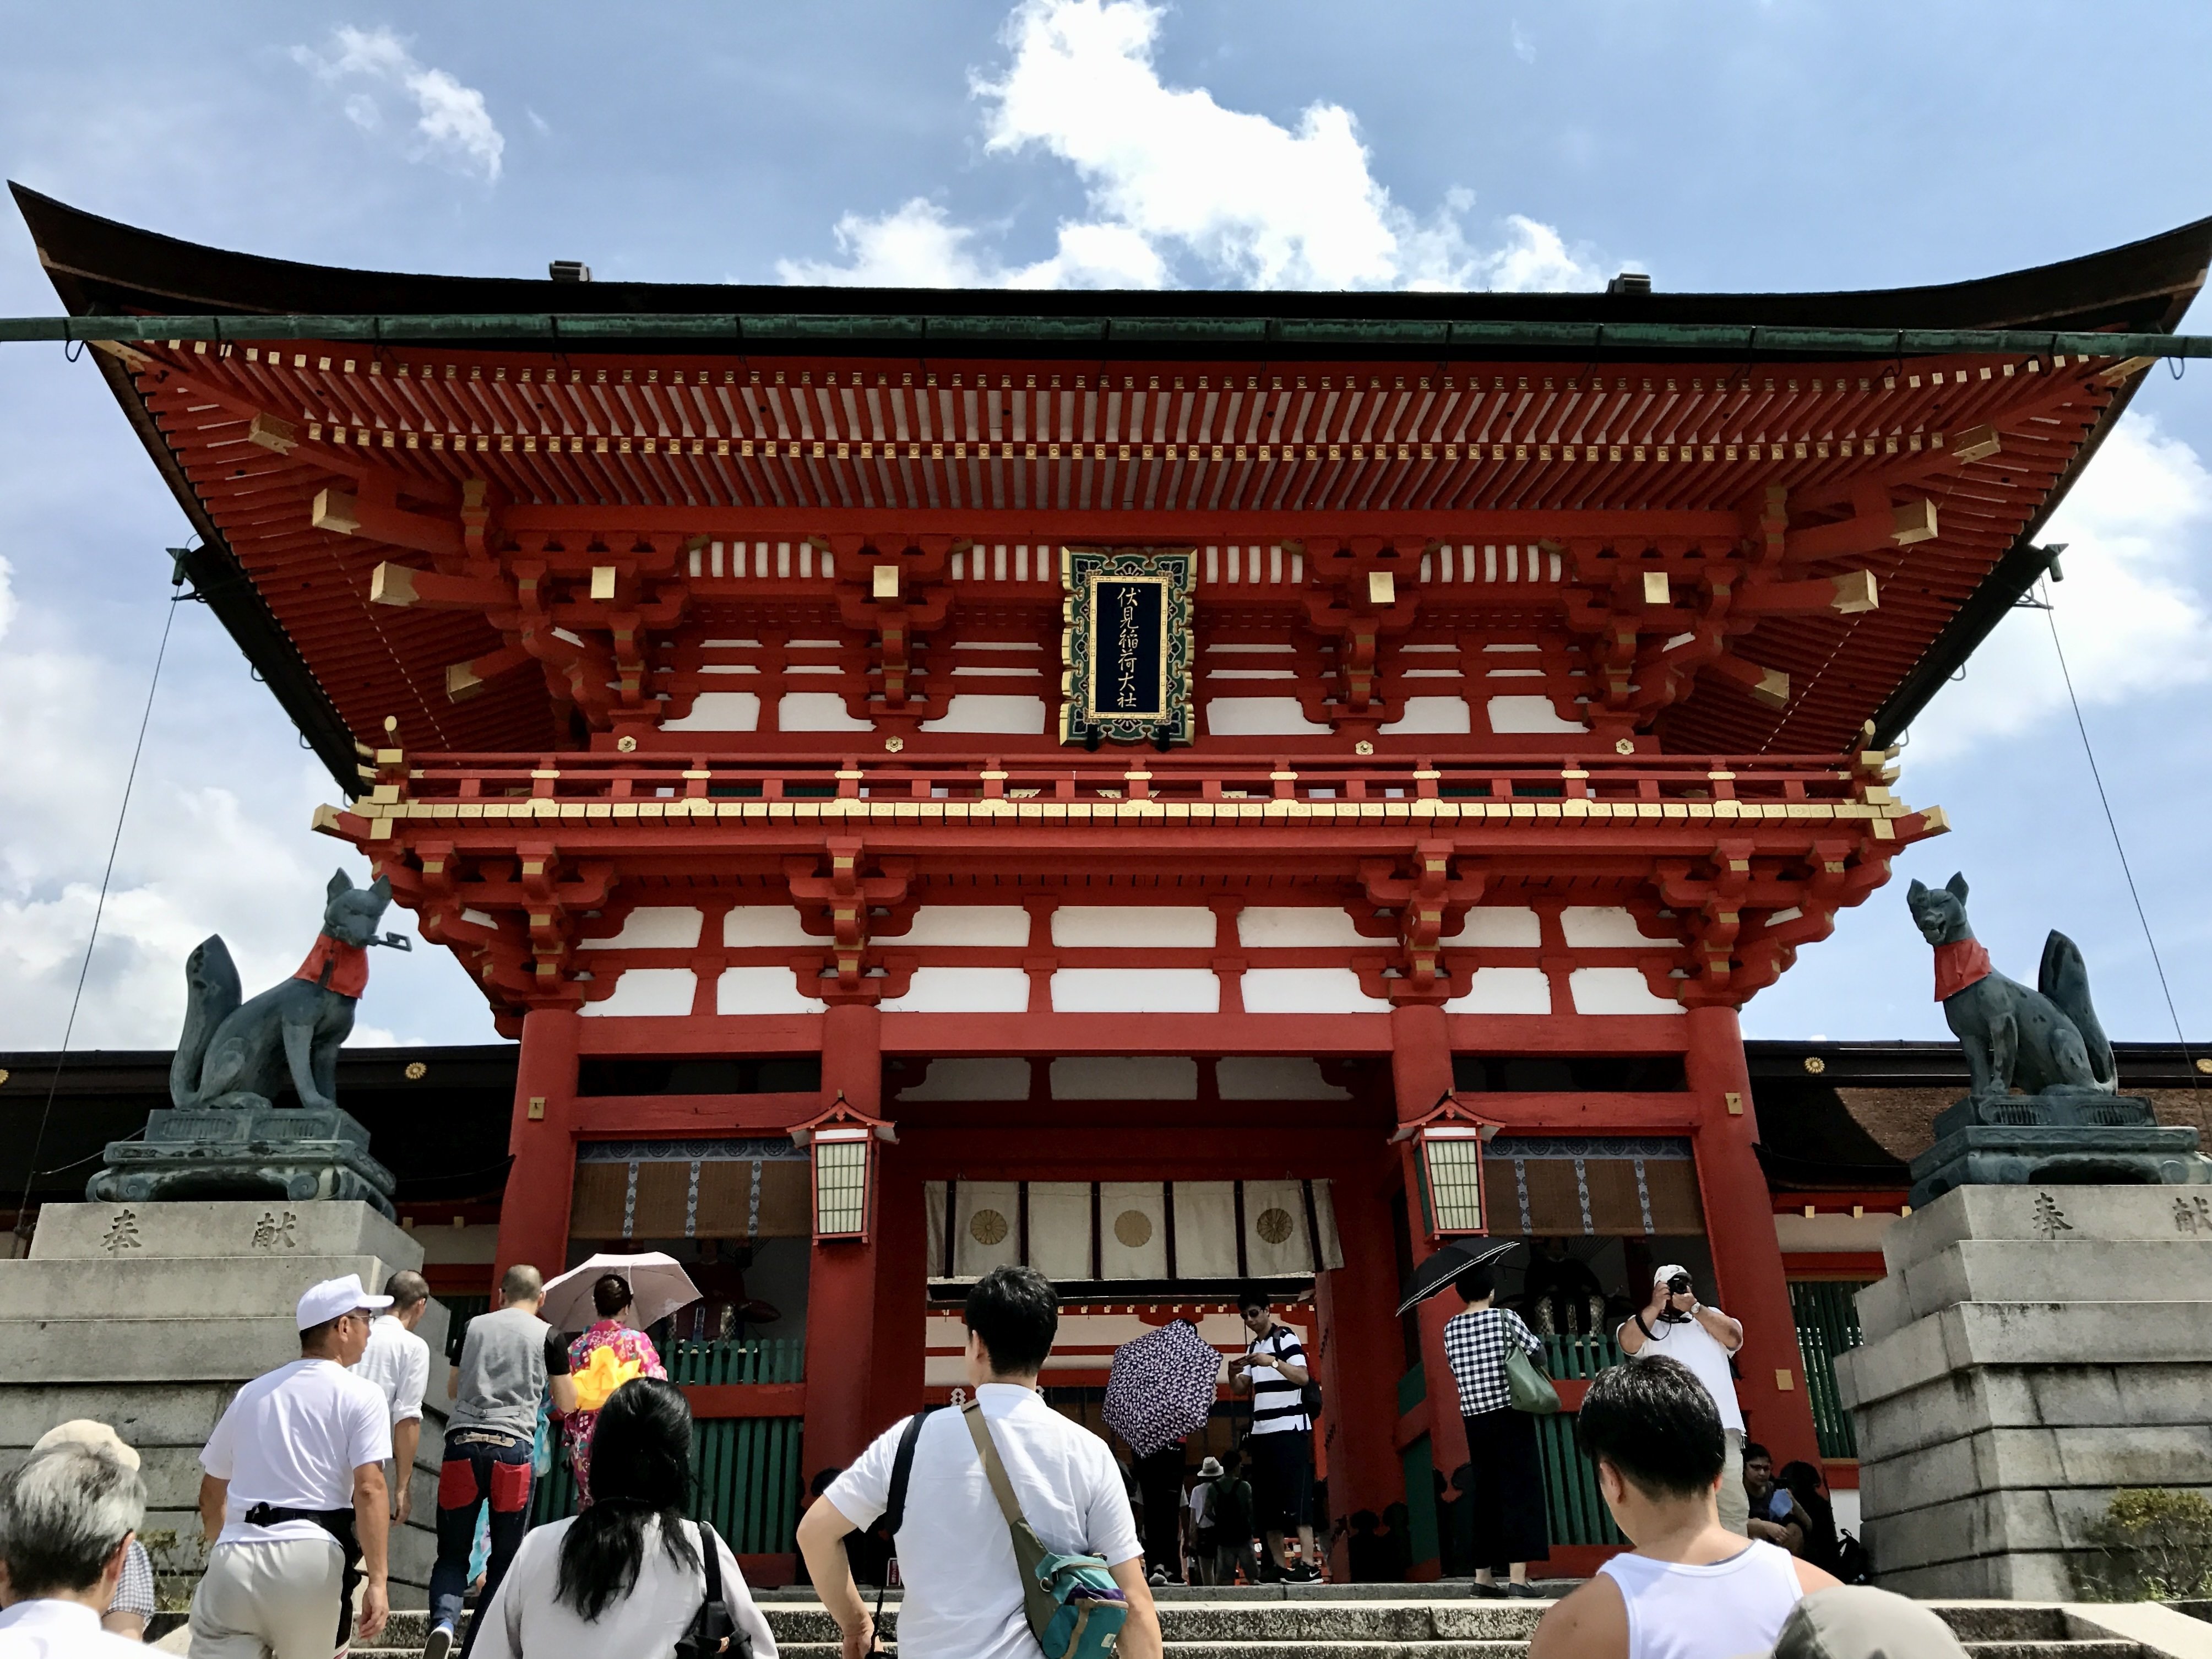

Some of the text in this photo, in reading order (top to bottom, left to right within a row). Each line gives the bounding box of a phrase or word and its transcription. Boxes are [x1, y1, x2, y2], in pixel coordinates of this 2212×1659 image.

[1117, 587, 1141, 708] 伏見稲荷大社
